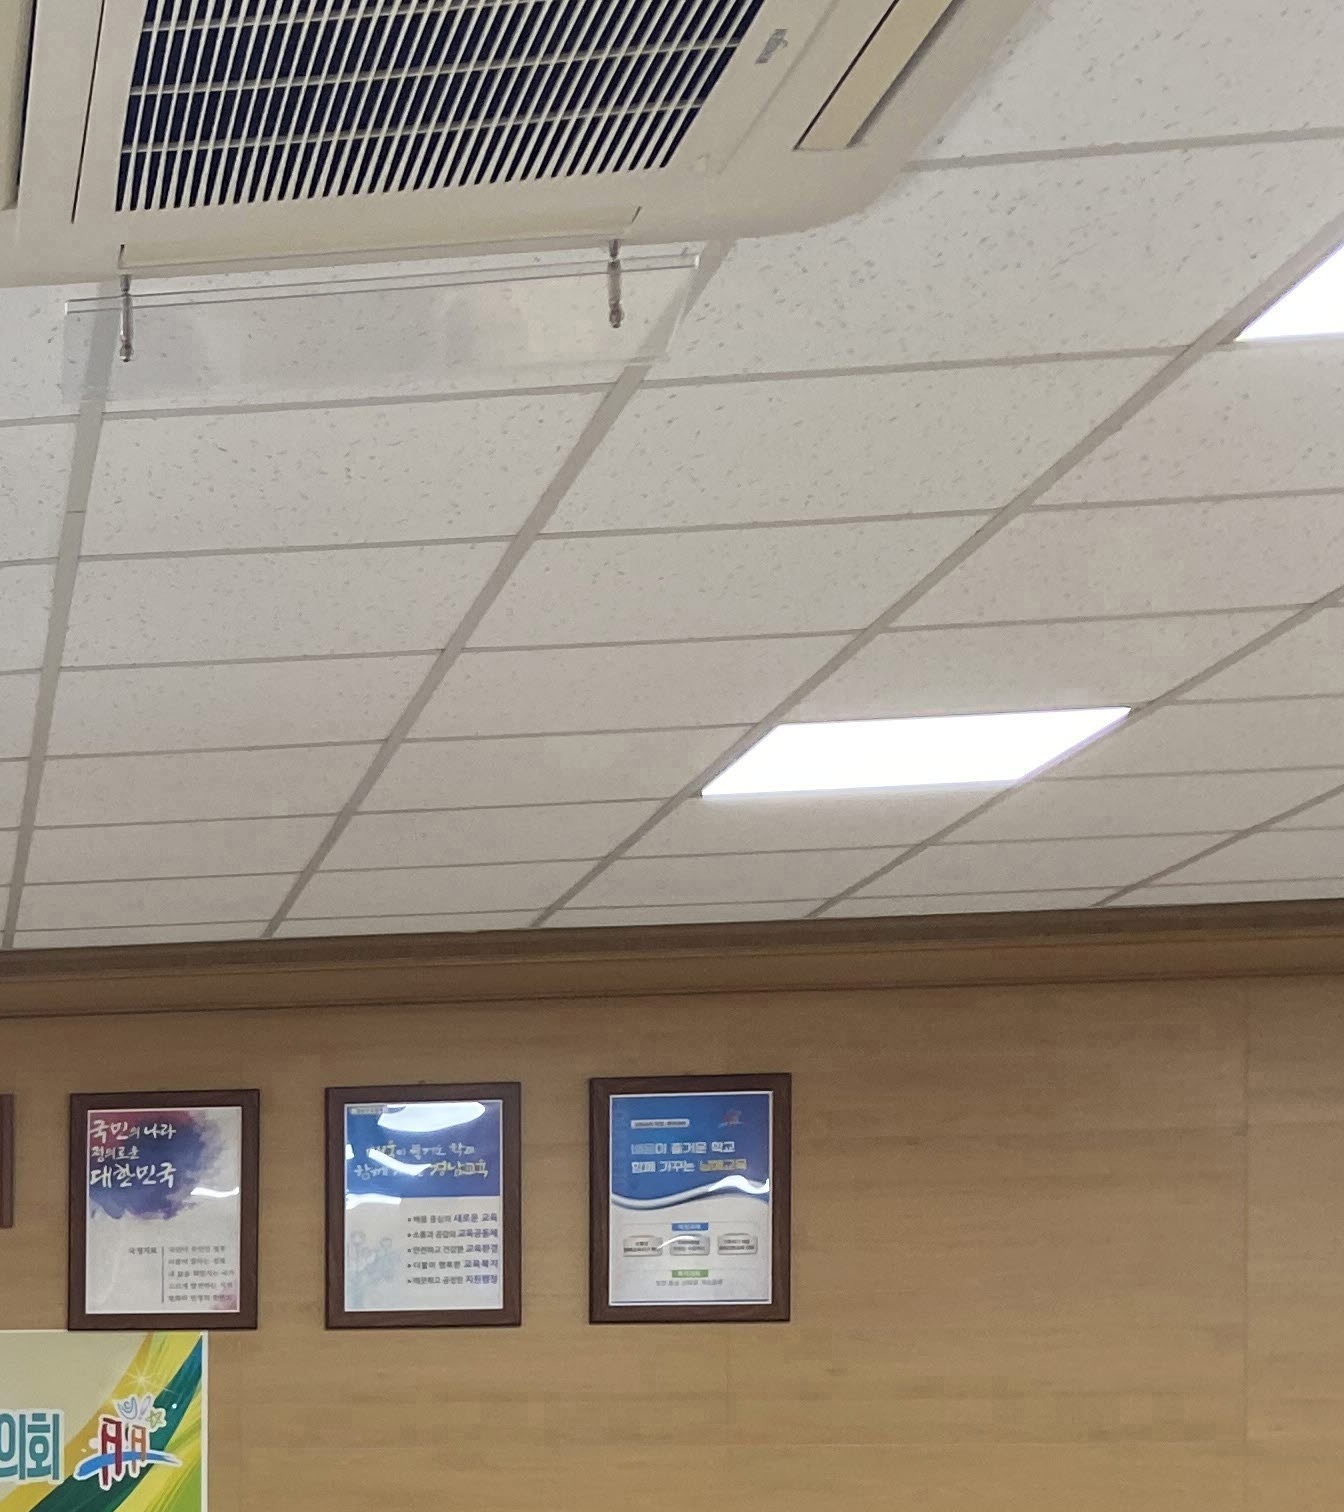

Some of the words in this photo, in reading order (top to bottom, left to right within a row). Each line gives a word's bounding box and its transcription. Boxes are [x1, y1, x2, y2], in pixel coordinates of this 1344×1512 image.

[89, 1119, 140, 1144] 국민의
[143, 1122, 177, 1140] 나라
[89, 1161, 177, 1189] 대한민국
